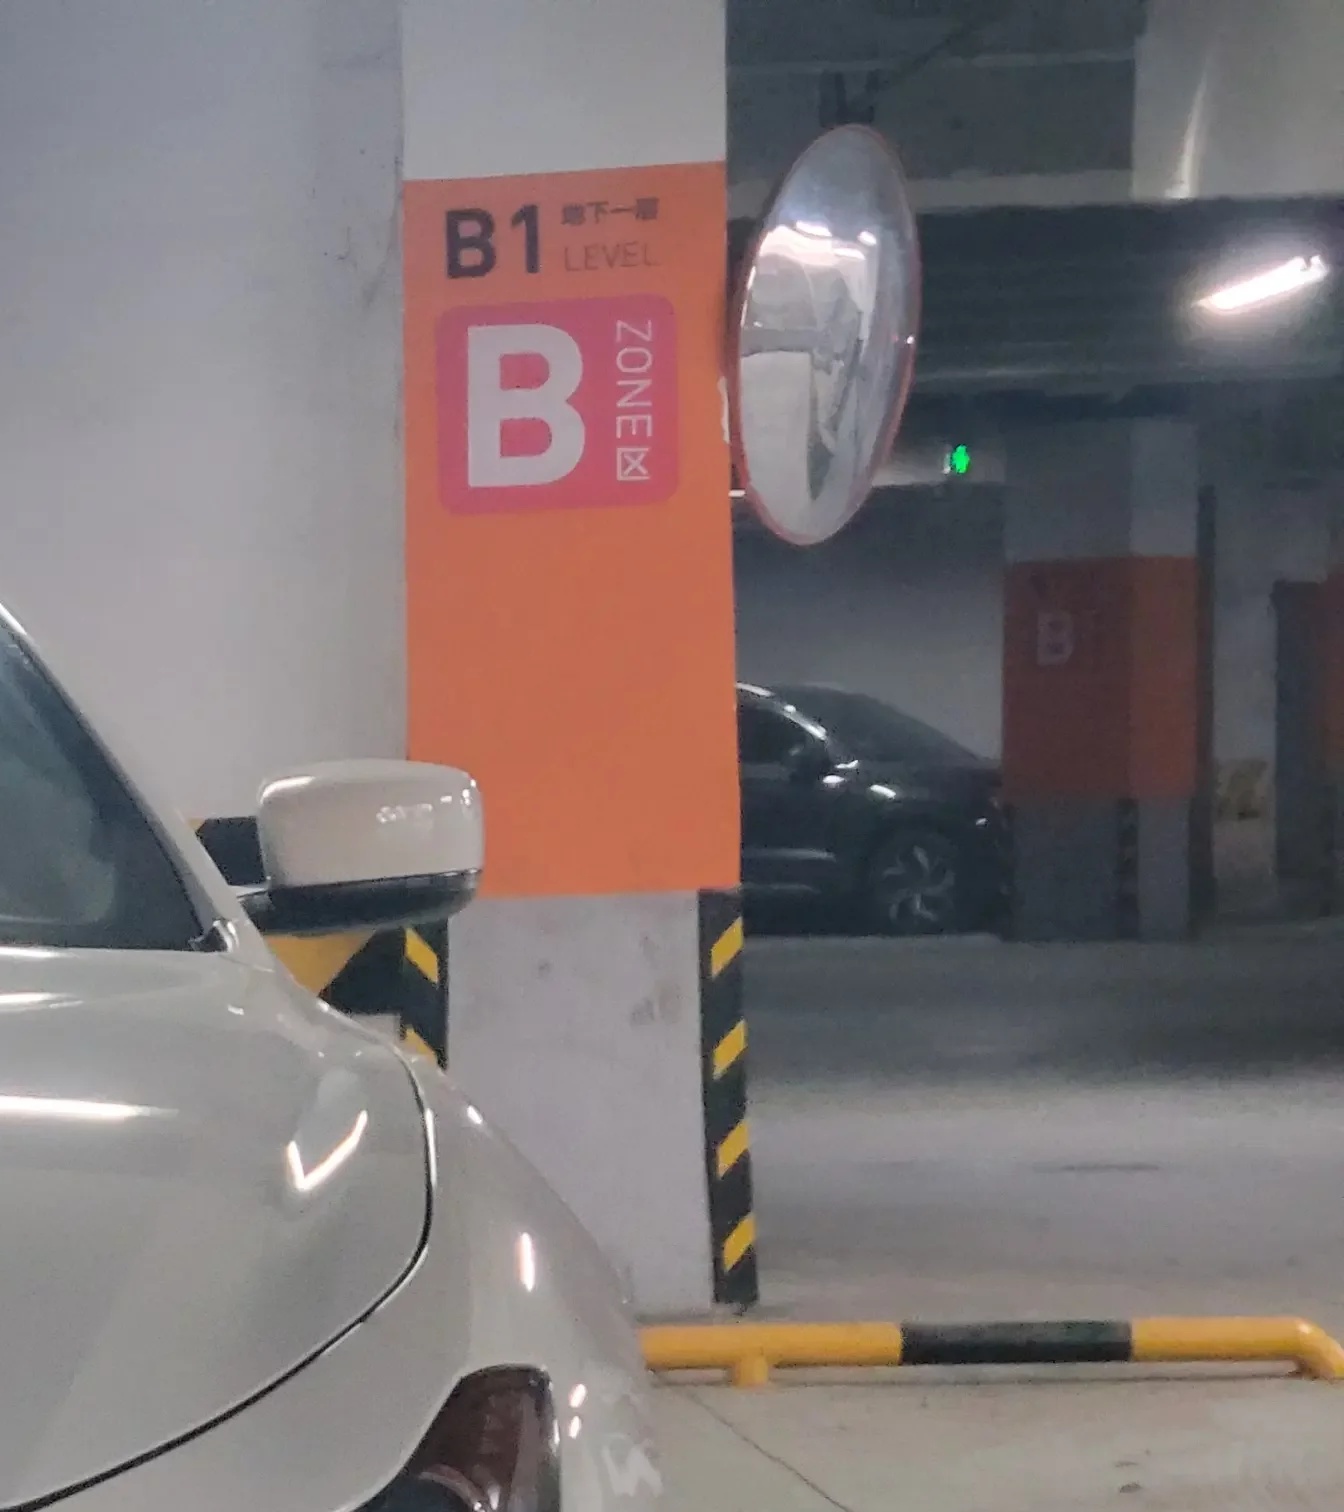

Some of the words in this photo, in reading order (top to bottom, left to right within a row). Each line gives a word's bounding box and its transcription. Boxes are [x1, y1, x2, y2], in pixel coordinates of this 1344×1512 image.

[445, 204, 541, 279] B1
[563, 240, 661, 272] LEVEL
[467, 323, 586, 488] B
[1037, 609, 1075, 666] B
